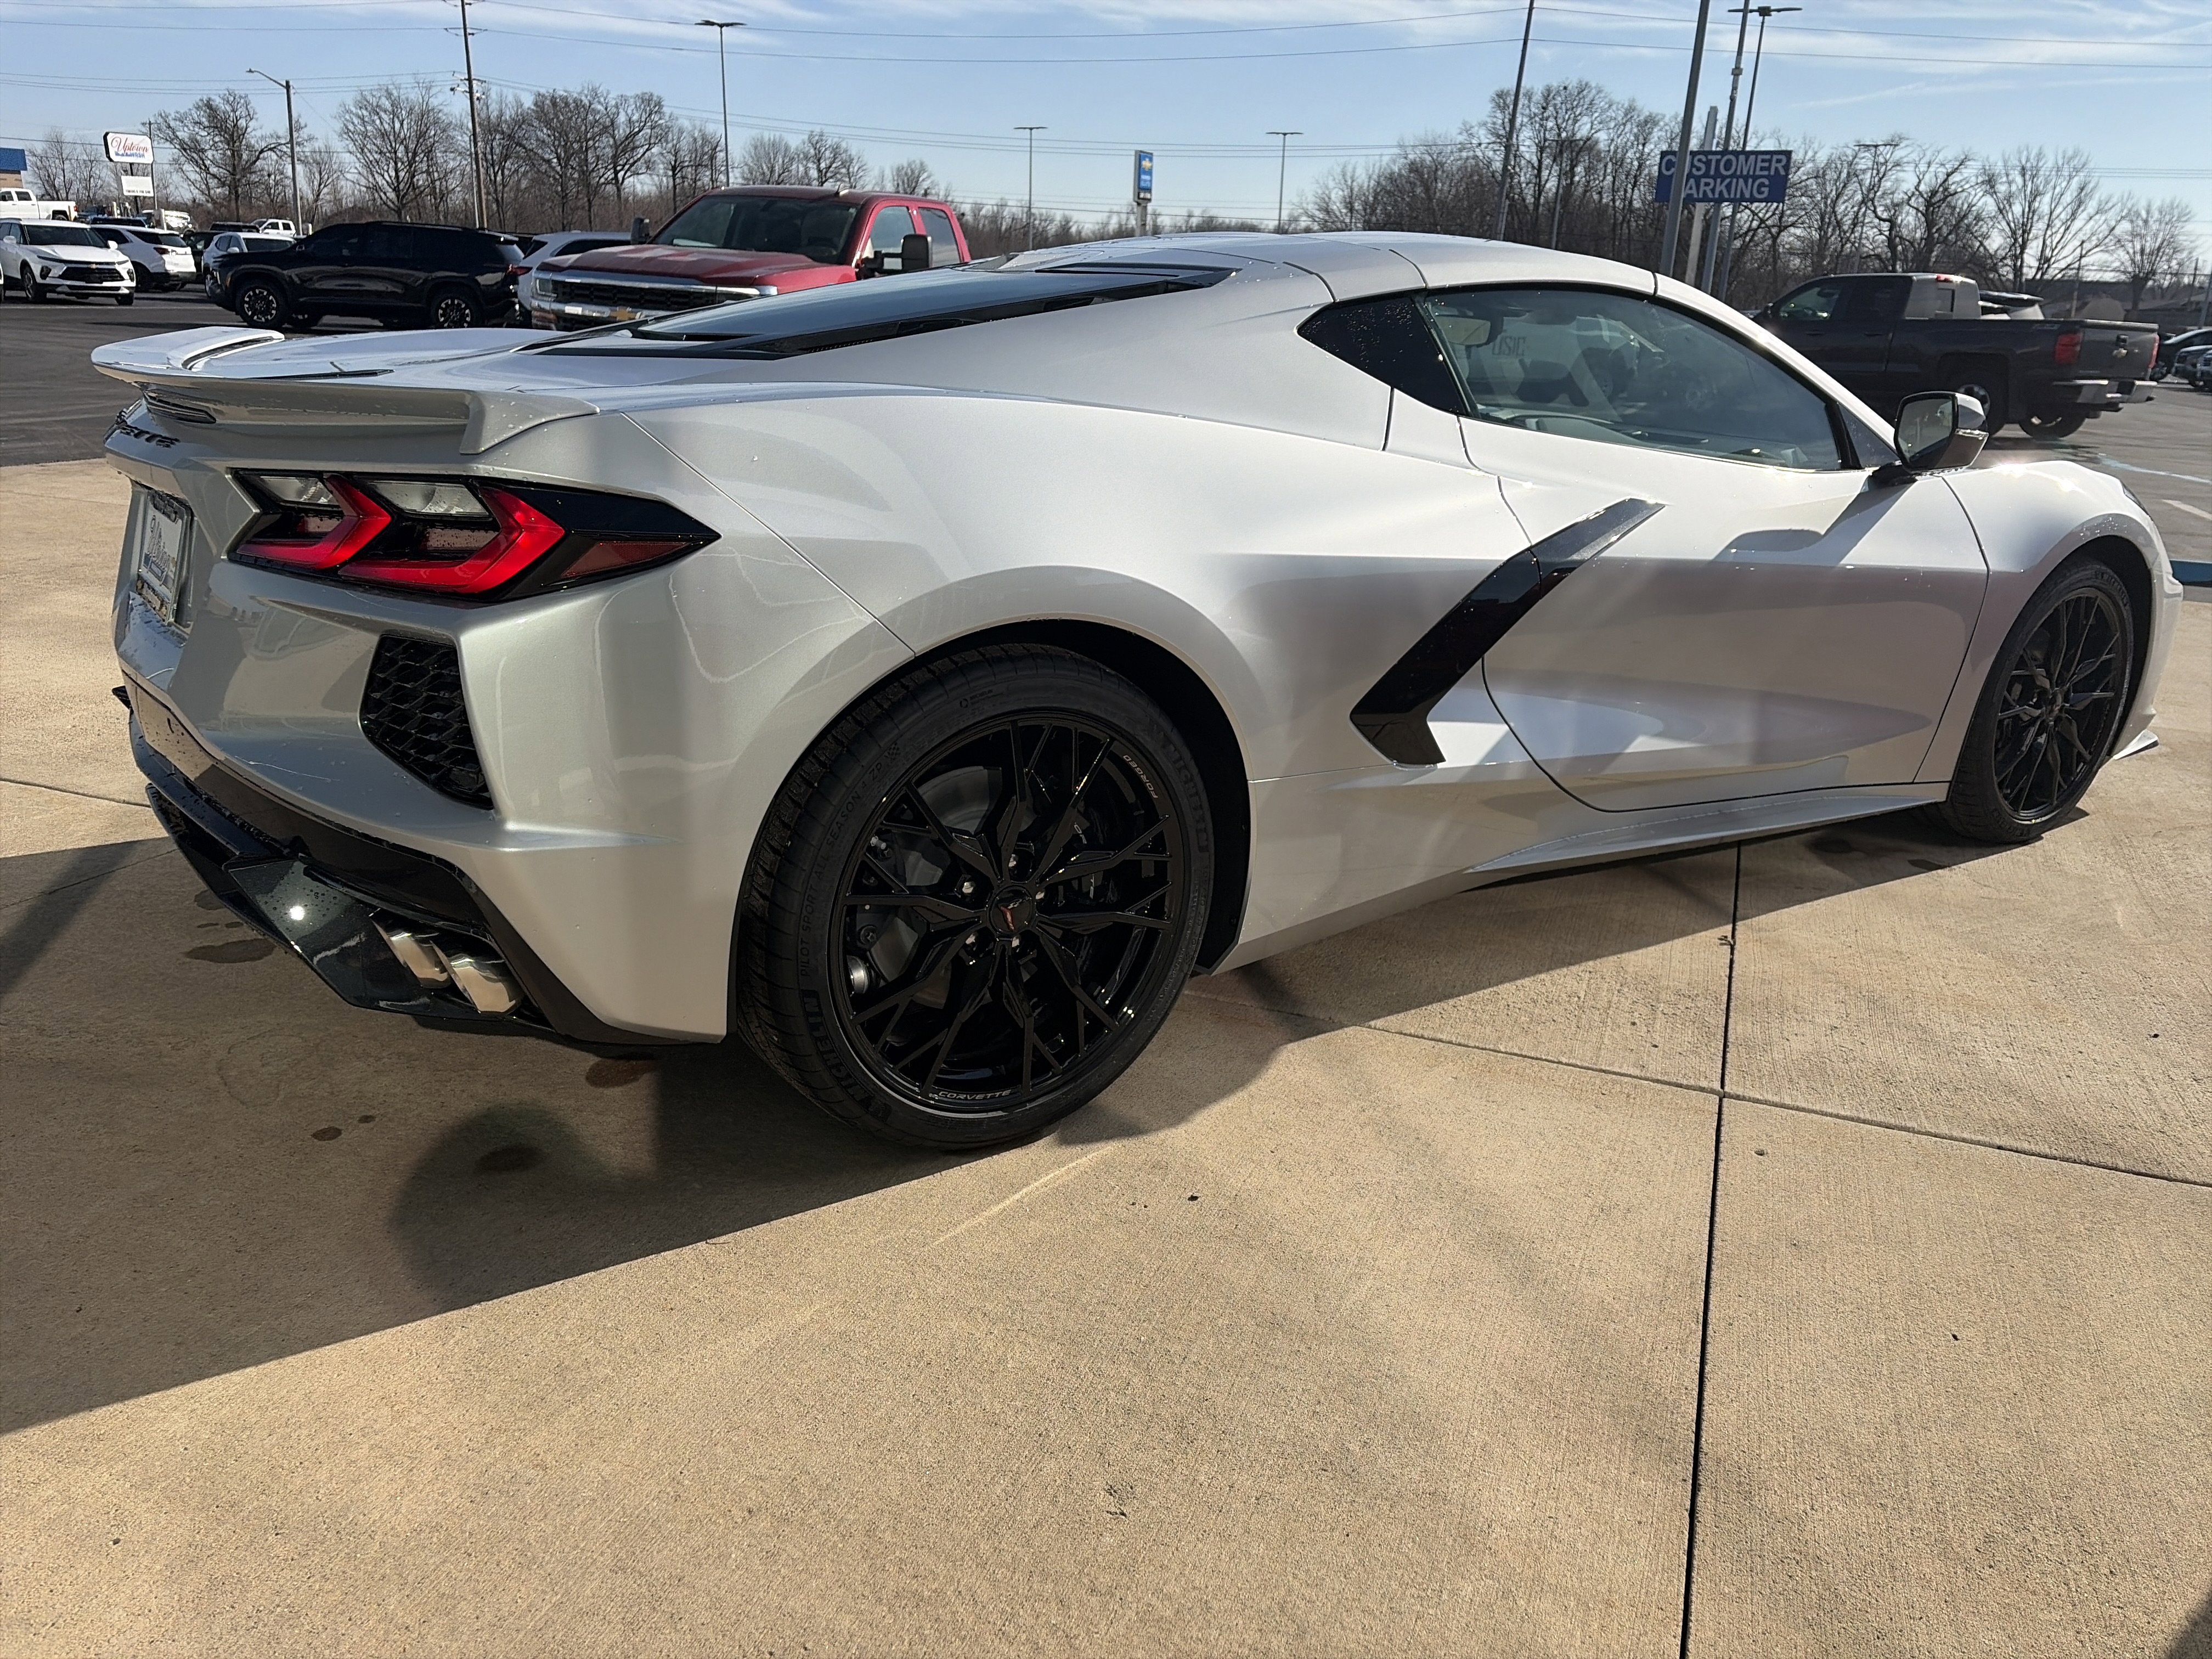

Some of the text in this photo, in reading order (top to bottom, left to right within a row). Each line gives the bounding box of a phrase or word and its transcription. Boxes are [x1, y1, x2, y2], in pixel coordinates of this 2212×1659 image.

[111, 136, 148, 155] Uptown
[1681, 178, 1770, 199] ARKING
[870, 762, 884, 781] ZP
[1123, 755, 1158, 798] FORGED
[826, 791, 861, 847] SEASON
[814, 853, 829, 880] ALL
[802, 884, 819, 933] SPORT
[799, 936, 811, 979] PILOT
[804, 997, 870, 1102] MICHELIN
[939, 1089, 1012, 1100] CORVETTE
